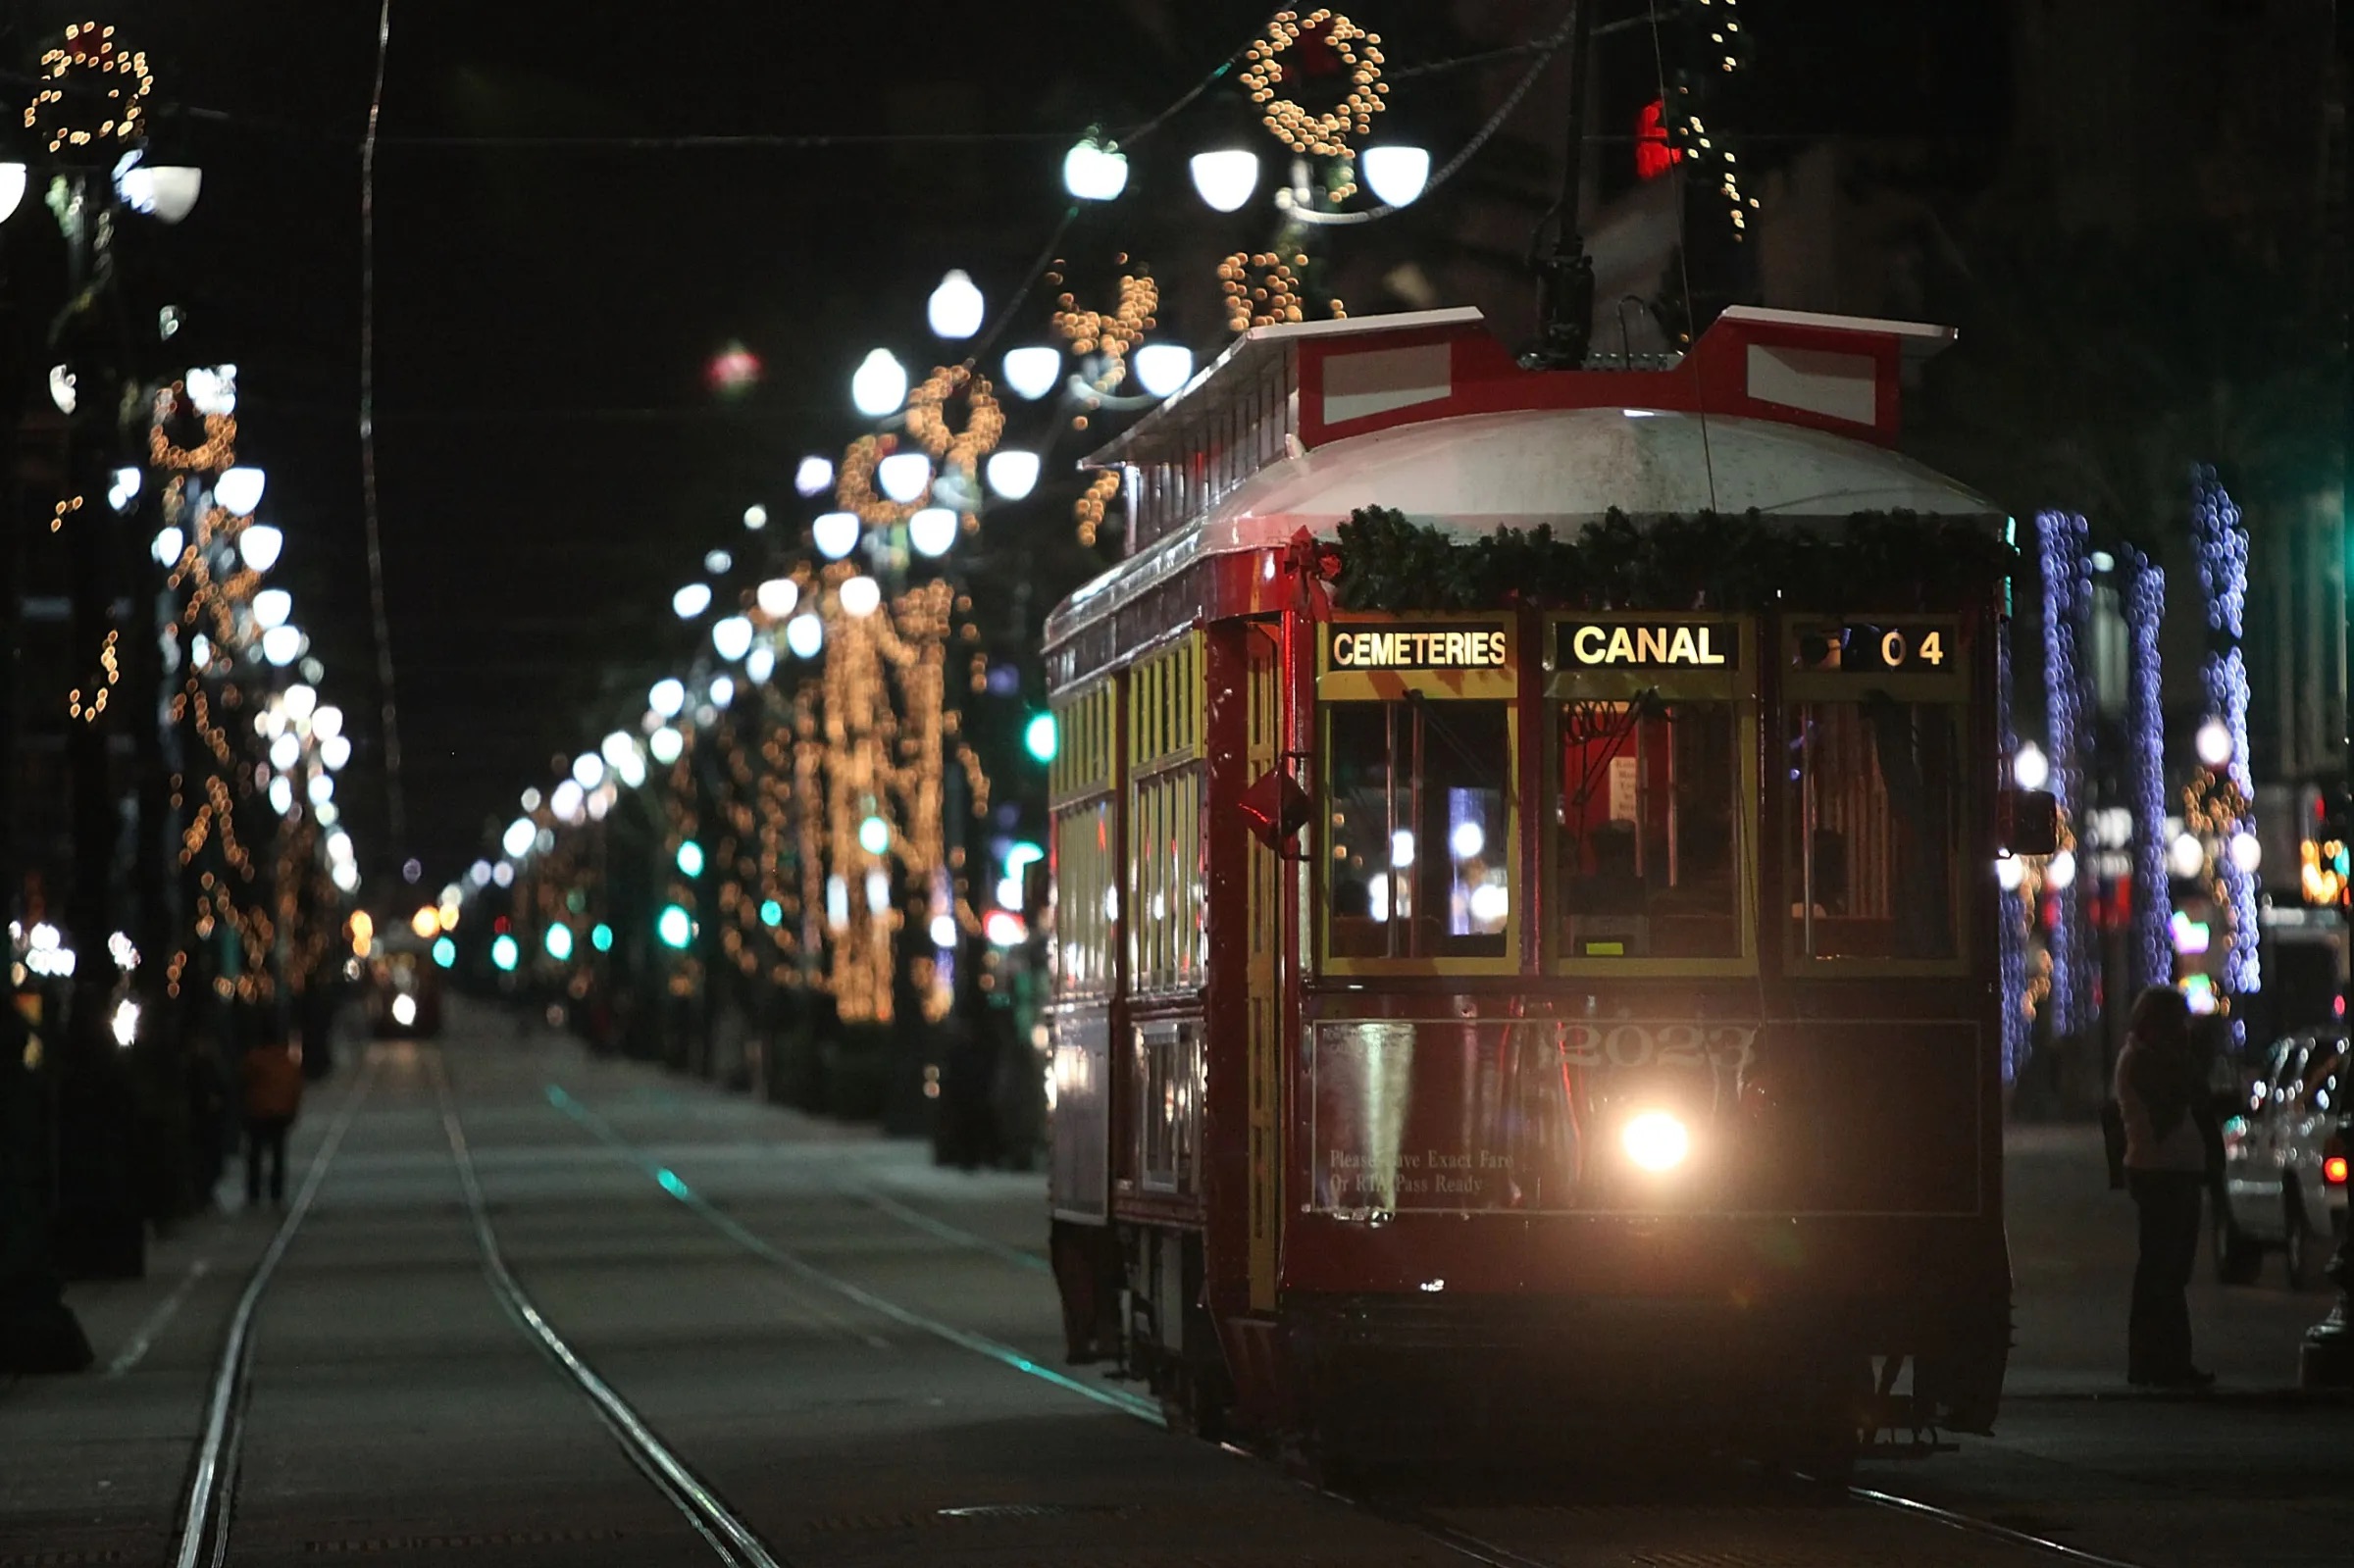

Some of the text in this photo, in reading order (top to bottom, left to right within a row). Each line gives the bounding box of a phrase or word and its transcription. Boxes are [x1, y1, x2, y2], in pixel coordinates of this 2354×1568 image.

[1334, 632, 1506, 666] CEMETERIES
[1573, 626, 1725, 664] CANAL
[1554, 1025, 1756, 1067] 2023
[1330, 1149, 1375, 1168] Please
[1428, 1149, 1472, 1168] Exact
[1480, 1149, 1513, 1168] Fare
[1330, 1174, 1348, 1193] Or
[1396, 1174, 1428, 1193] Pass
[1436, 1174, 1483, 1195] Ready
